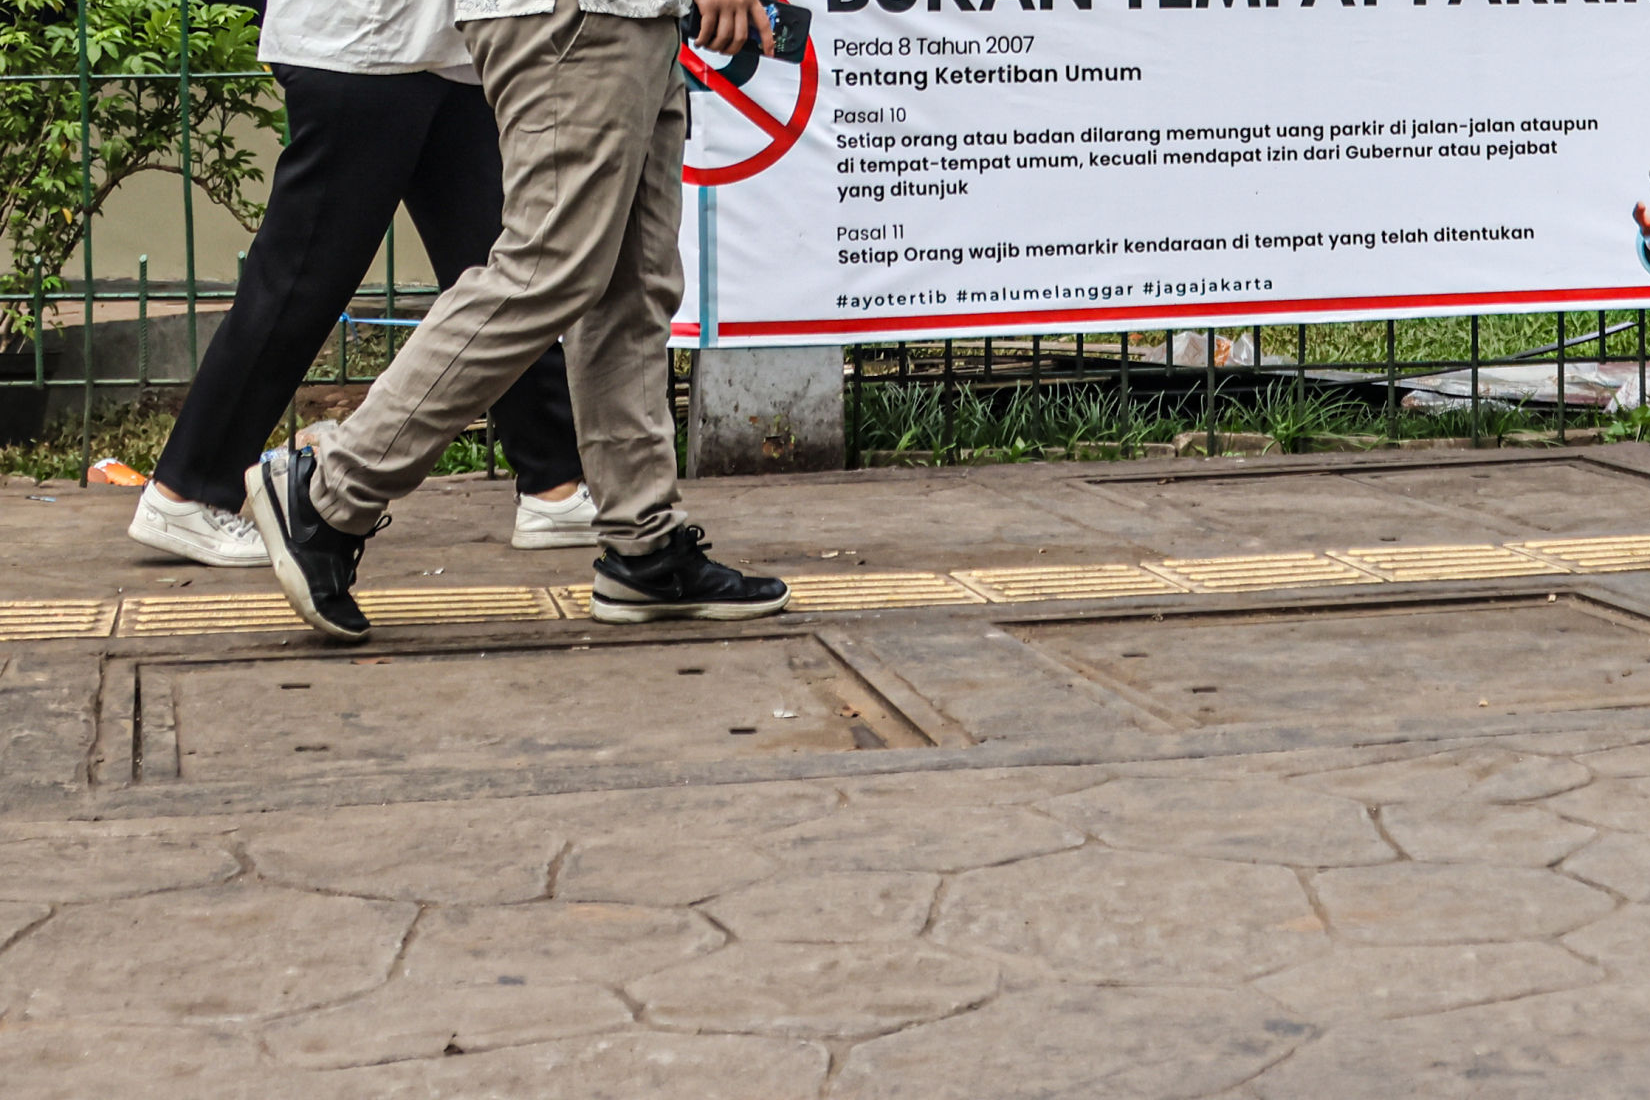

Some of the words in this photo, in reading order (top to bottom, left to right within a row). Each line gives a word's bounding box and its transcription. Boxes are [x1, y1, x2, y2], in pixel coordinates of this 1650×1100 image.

[834, 38, 892, 56] Perda
[899, 37, 910, 55] 8
[916, 37, 980, 55] Tahun
[986, 36, 1034, 53] 2007
[832, 69, 927, 91] Tentang
[936, 65, 1057, 84] Ketertiban
[1066, 65, 1141, 81] Umum
[834, 108, 883, 123] Pasal
[890, 108, 906, 122] 10
[837, 133, 895, 152] Setiap
[901, 135, 957, 151] orang
[963, 132, 1007, 145] atau
[1014, 129, 1074, 144] badan
[1081, 127, 1160, 145] dilarang
[1167, 125, 1270, 143] memungut
[1277, 126, 1323, 141] uang
[1331, 120, 1384, 141] parkir
[1390, 120, 1406, 134] di
[1412, 118, 1514, 139] jalan-jalan
[1521, 118, 1597, 135] ataupun
[837, 158, 854, 173] di
[860, 155, 1010, 176] tempat-tempat
[1017, 156, 1083, 169] umum,
[1090, 150, 1156, 166] kecuali
[1164, 148, 1261, 167] mendapat
[1268, 146, 1297, 161] izin
[1304, 145, 1339, 160] dari
[1346, 145, 1433, 159] Gubernur
[1439, 143, 1480, 156] atau
[1487, 140, 1557, 160] pejabat
[838, 185, 884, 203] yang
[891, 180, 967, 200] ditunjuk
[837, 225, 886, 241] Pasal
[893, 224, 903, 239] 11
[839, 248, 898, 267] Setiap
[904, 247, 963, 264] Orang
[969, 242, 1019, 263] wajib
[1026, 239, 1118, 256] memarkir
[1125, 237, 1226, 253] kendaraan
[1233, 234, 1248, 249] di
[1255, 233, 1323, 251] tempat
[1329, 234, 1375, 250] yang
[1381, 229, 1427, 243] telah
[1434, 226, 1534, 242] ditentukan
[837, 290, 946, 310] #ayotertib
[957, 285, 1133, 302] #malumelanggar
[1143, 278, 1272, 297] #jagajakarta
